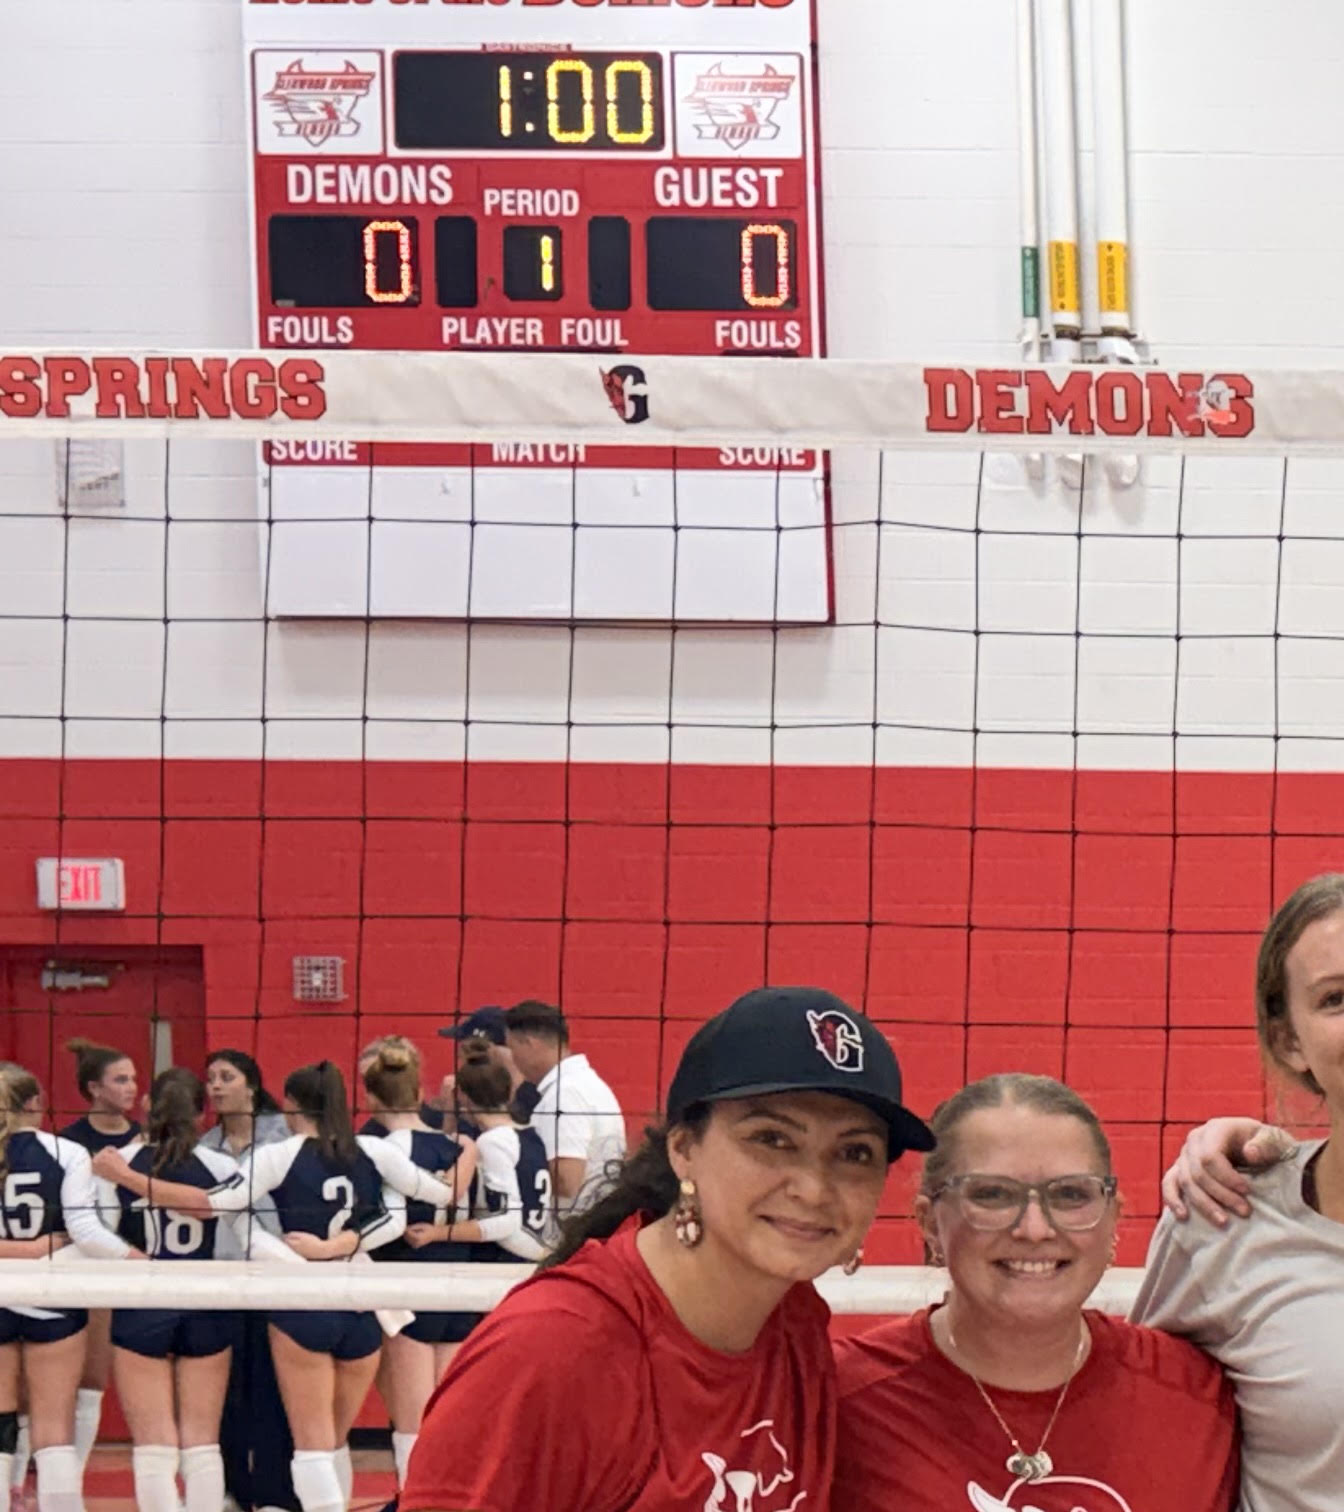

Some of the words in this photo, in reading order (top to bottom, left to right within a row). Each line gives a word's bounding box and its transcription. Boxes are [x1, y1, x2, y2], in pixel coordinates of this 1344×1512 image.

[499, 60, 654, 144] 1:00
[287, 164, 453, 206] DEMONS
[484, 189, 579, 217] PERIOD
[654, 166, 784, 208] GUEST
[362, 220, 411, 303] 0
[540, 233, 554, 292] 1
[740, 224, 789, 307] 0
[267, 316, 354, 343] FOULS
[442, 317, 544, 345] PLAYER
[561, 318, 629, 346] FOUL
[715, 320, 802, 348] FOULS
[0, 357, 327, 421] SPRINGS
[923, 368, 1254, 438] DEMONS
[271, 439, 357, 461] SCORE
[56, 866, 102, 902] EXIT
[0, 1172, 45, 1239] 5
